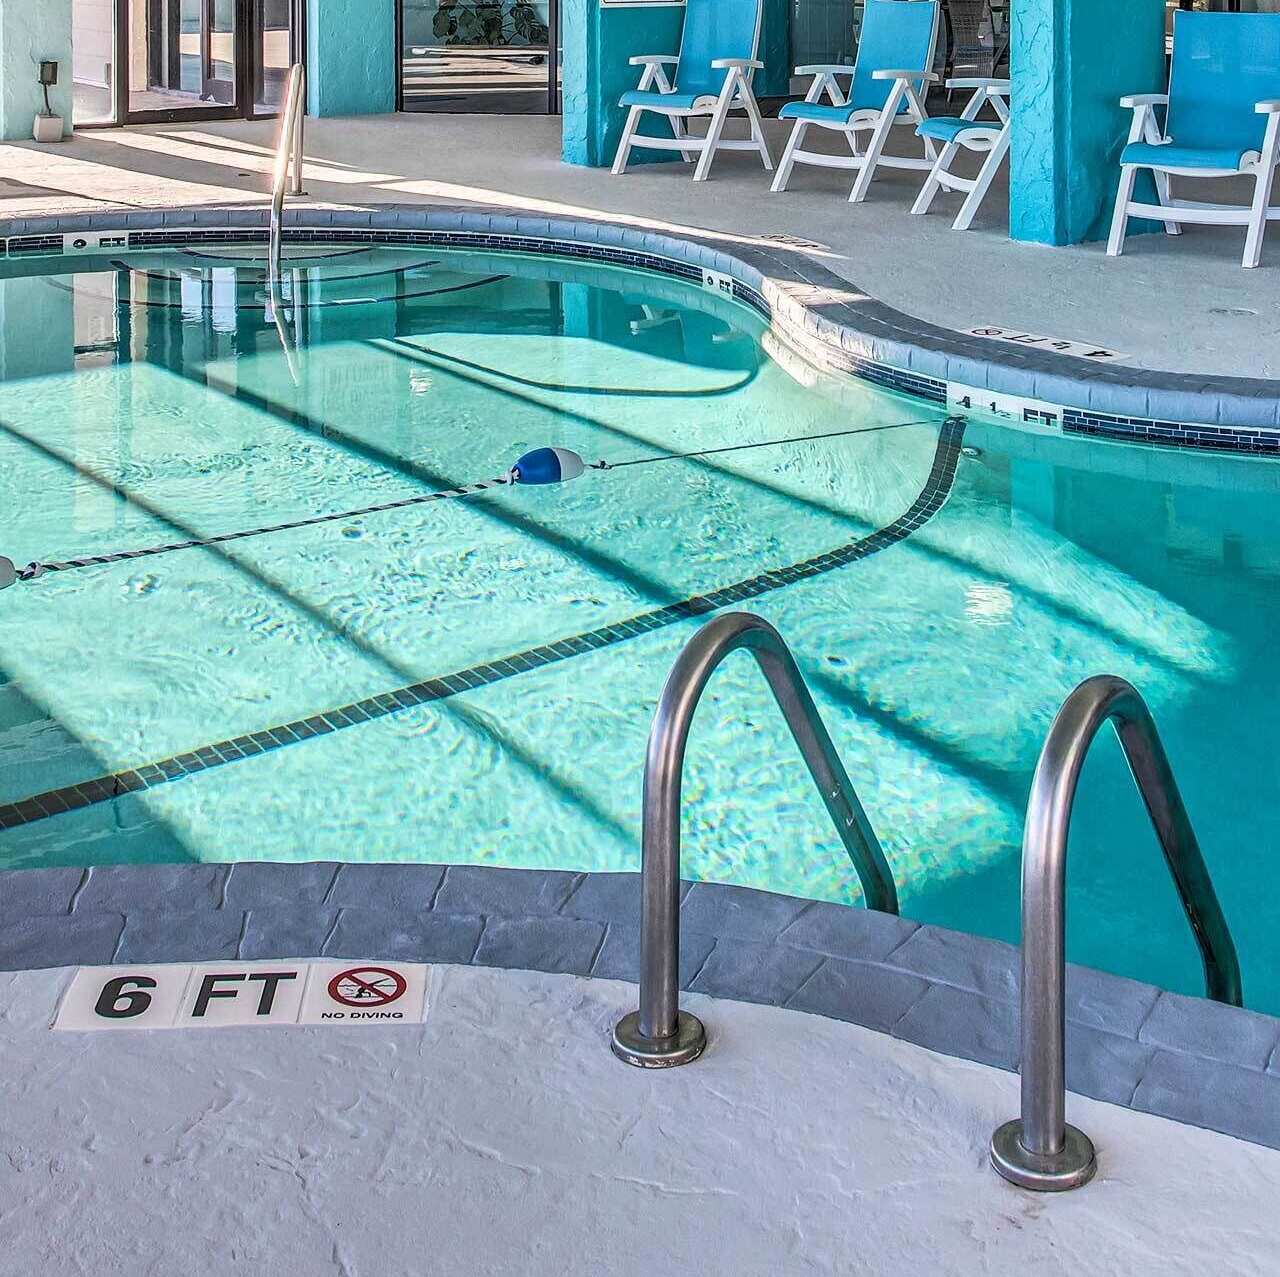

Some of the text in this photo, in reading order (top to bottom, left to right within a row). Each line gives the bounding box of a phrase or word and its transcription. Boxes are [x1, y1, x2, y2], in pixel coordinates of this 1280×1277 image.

[1023, 407, 1058, 426] FT
[93, 971, 298, 1019] 6 FT
[321, 1011, 405, 1020] NO DIVING
